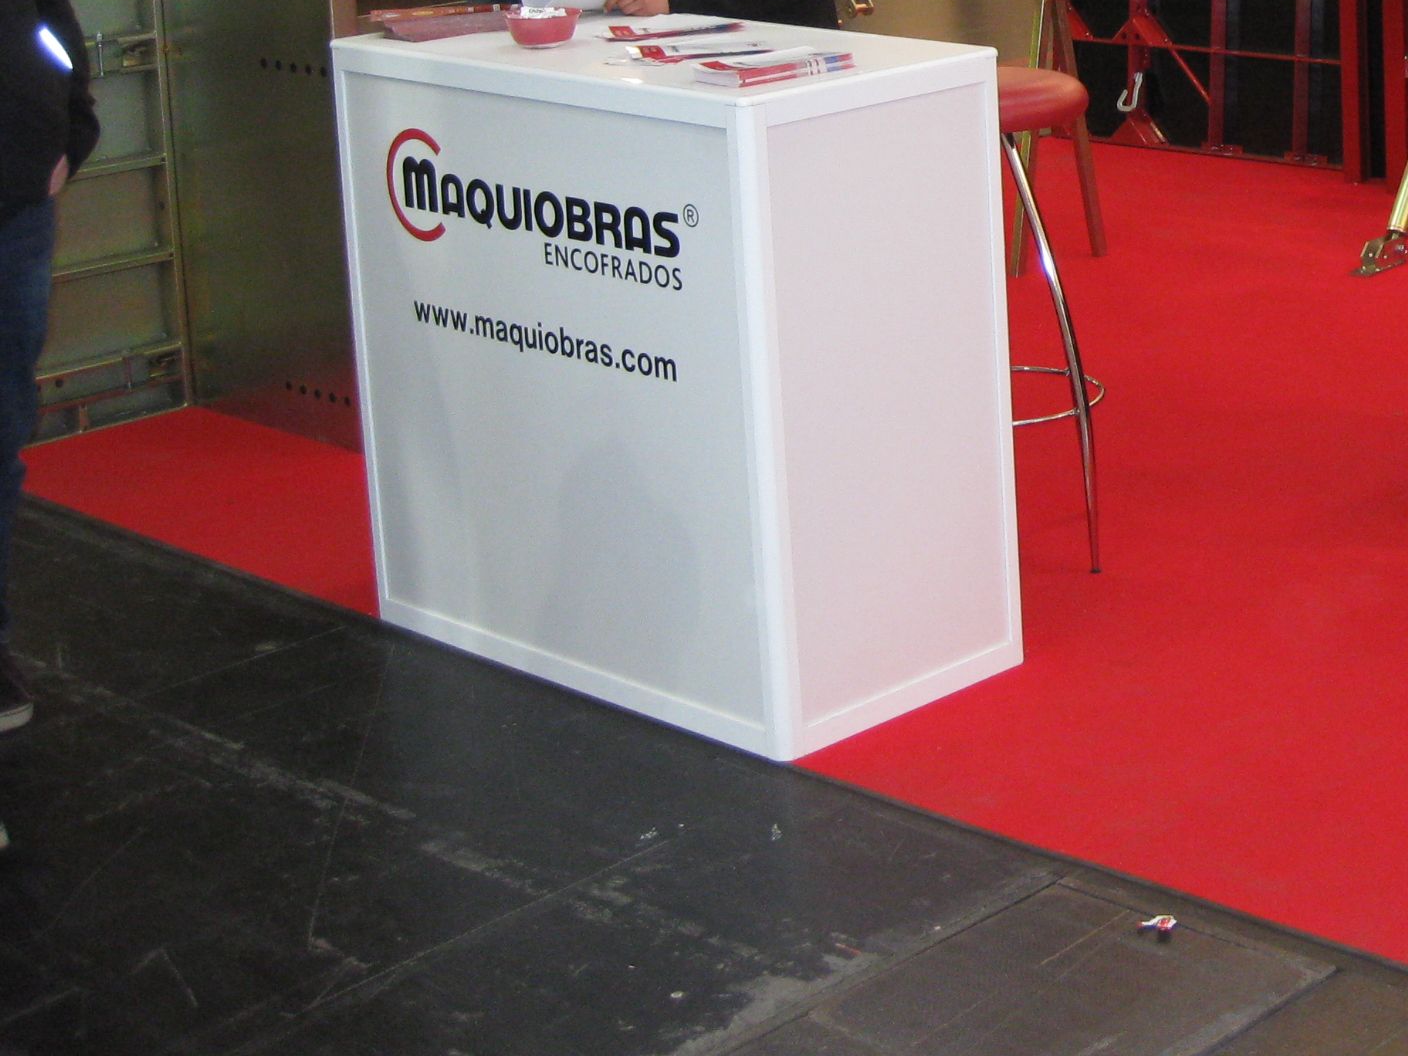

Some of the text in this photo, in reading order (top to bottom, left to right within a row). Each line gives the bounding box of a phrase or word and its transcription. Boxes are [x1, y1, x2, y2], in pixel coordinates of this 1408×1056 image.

[402, 155, 681, 258] MAQUIOBRAS
[544, 242, 682, 290] ENCOFRADOS
[414, 300, 678, 382] www.maquiobras.com
